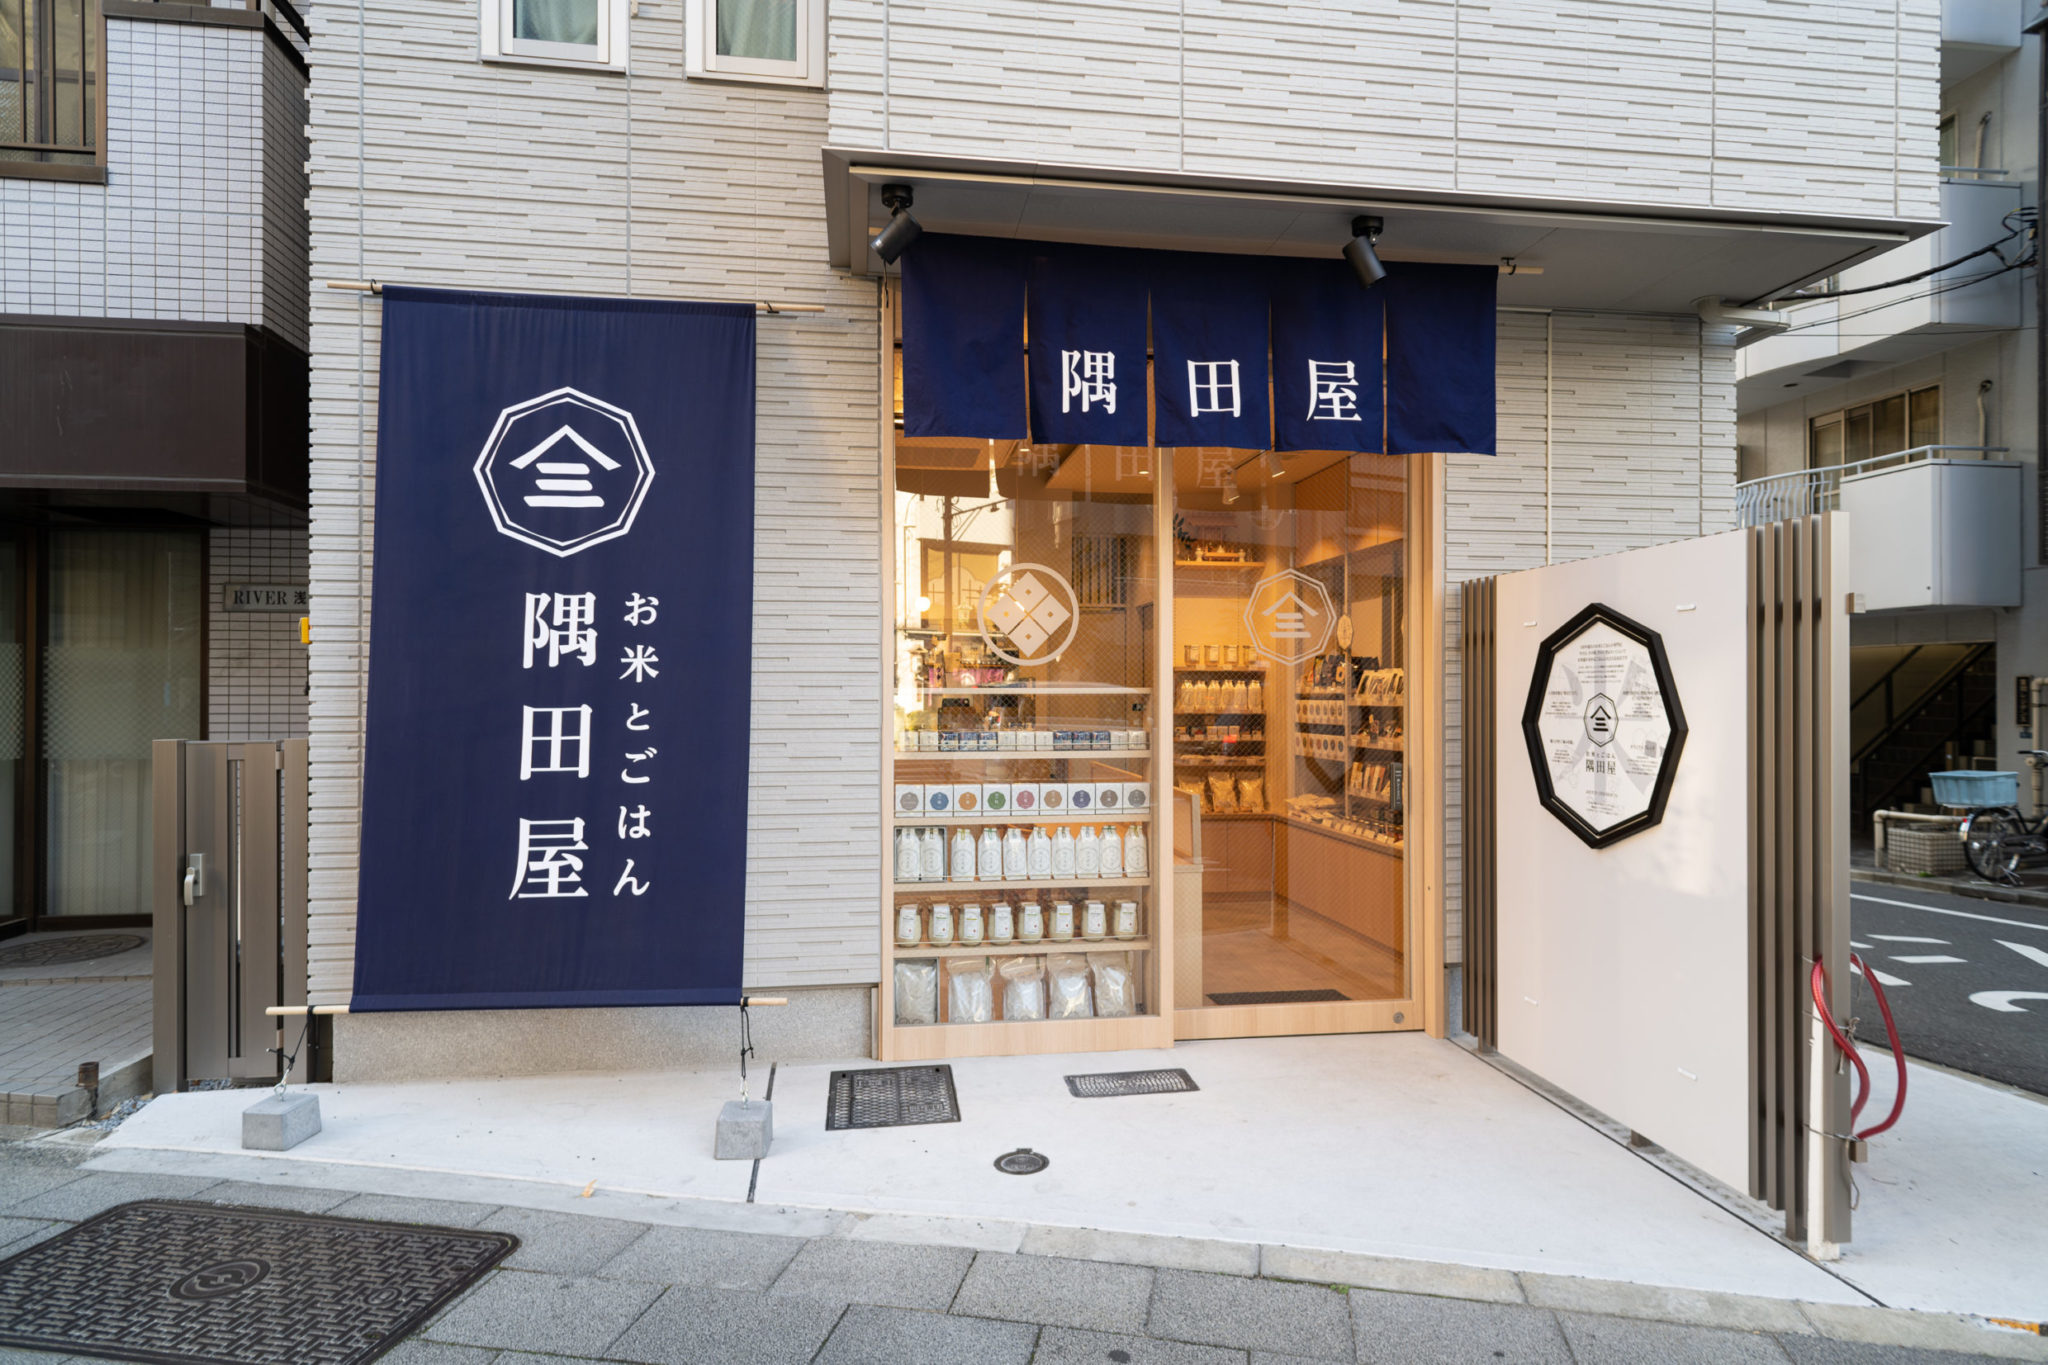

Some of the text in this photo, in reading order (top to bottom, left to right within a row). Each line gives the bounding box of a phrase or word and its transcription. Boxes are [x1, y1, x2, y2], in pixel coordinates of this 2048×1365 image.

[1060, 350, 1362, 421] 隅田屋
[234, 590, 287, 605] RIVER
[508, 591, 599, 901] 隅田屋
[613, 591, 660, 897] お米とごはん
